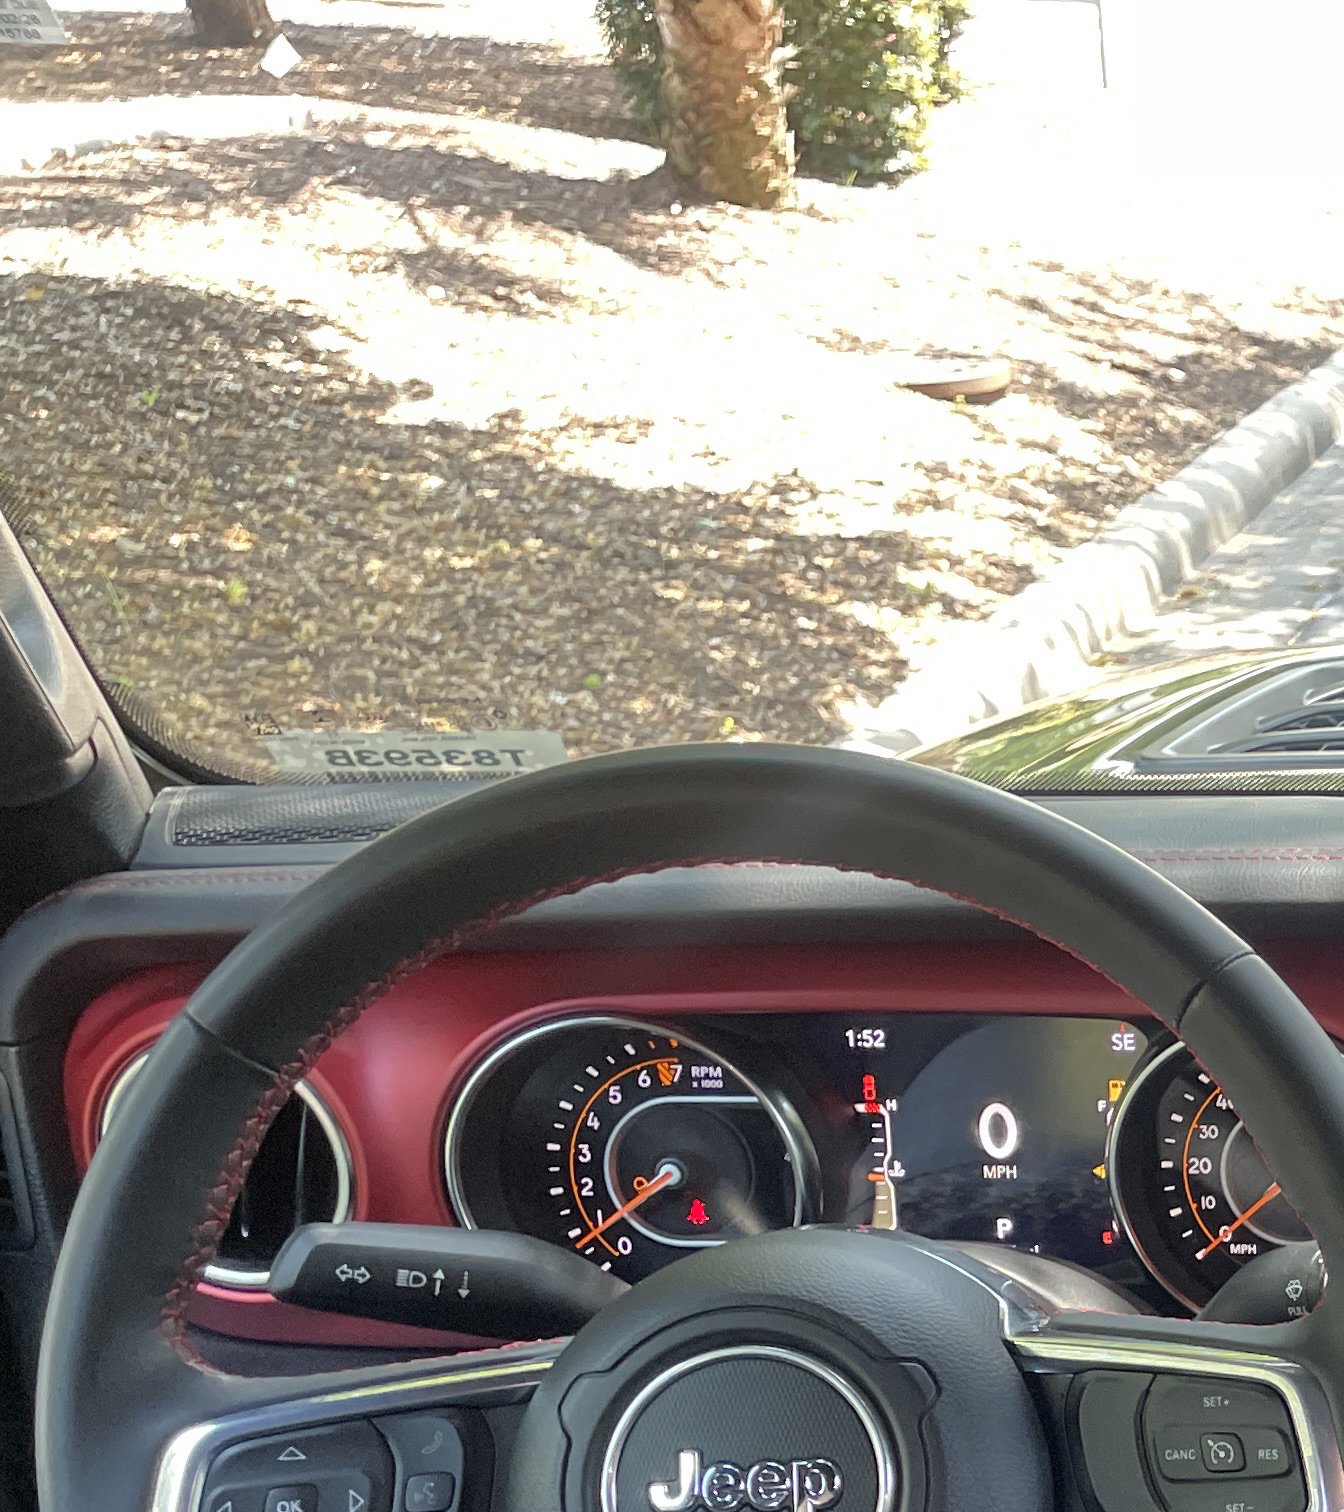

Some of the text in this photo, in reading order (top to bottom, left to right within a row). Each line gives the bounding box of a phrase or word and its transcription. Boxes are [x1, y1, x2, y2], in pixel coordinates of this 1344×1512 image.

[845, 1029, 886, 1048] 1:52
[1111, 1033, 1136, 1051] SE
[638, 1070, 651, 1088] 6
[670, 1064, 683, 1083] 7
[691, 1066, 722, 1079] RPM
[608, 1086, 622, 1105] 5
[886, 1099, 897, 1111] H
[1097, 1100, 1107, 1112] F
[586, 1112, 600, 1130] 4
[978, 1102, 1018, 1159] 0
[1199, 1125, 1219, 1140] 30
[577, 1144, 592, 1163] 3
[983, 1165, 1018, 1180] MPH
[1187, 1157, 1212, 1174] 20
[580, 1179, 594, 1196] 2
[1200, 1195, 1216, 1210] 10
[996, 1218, 1012, 1239] P
[617, 1237, 632, 1256] 0
[1229, 1244, 1257, 1256] MPH
[1164, 1449, 1196, 1461] CANC
[1258, 1449, 1279, 1460] RES
